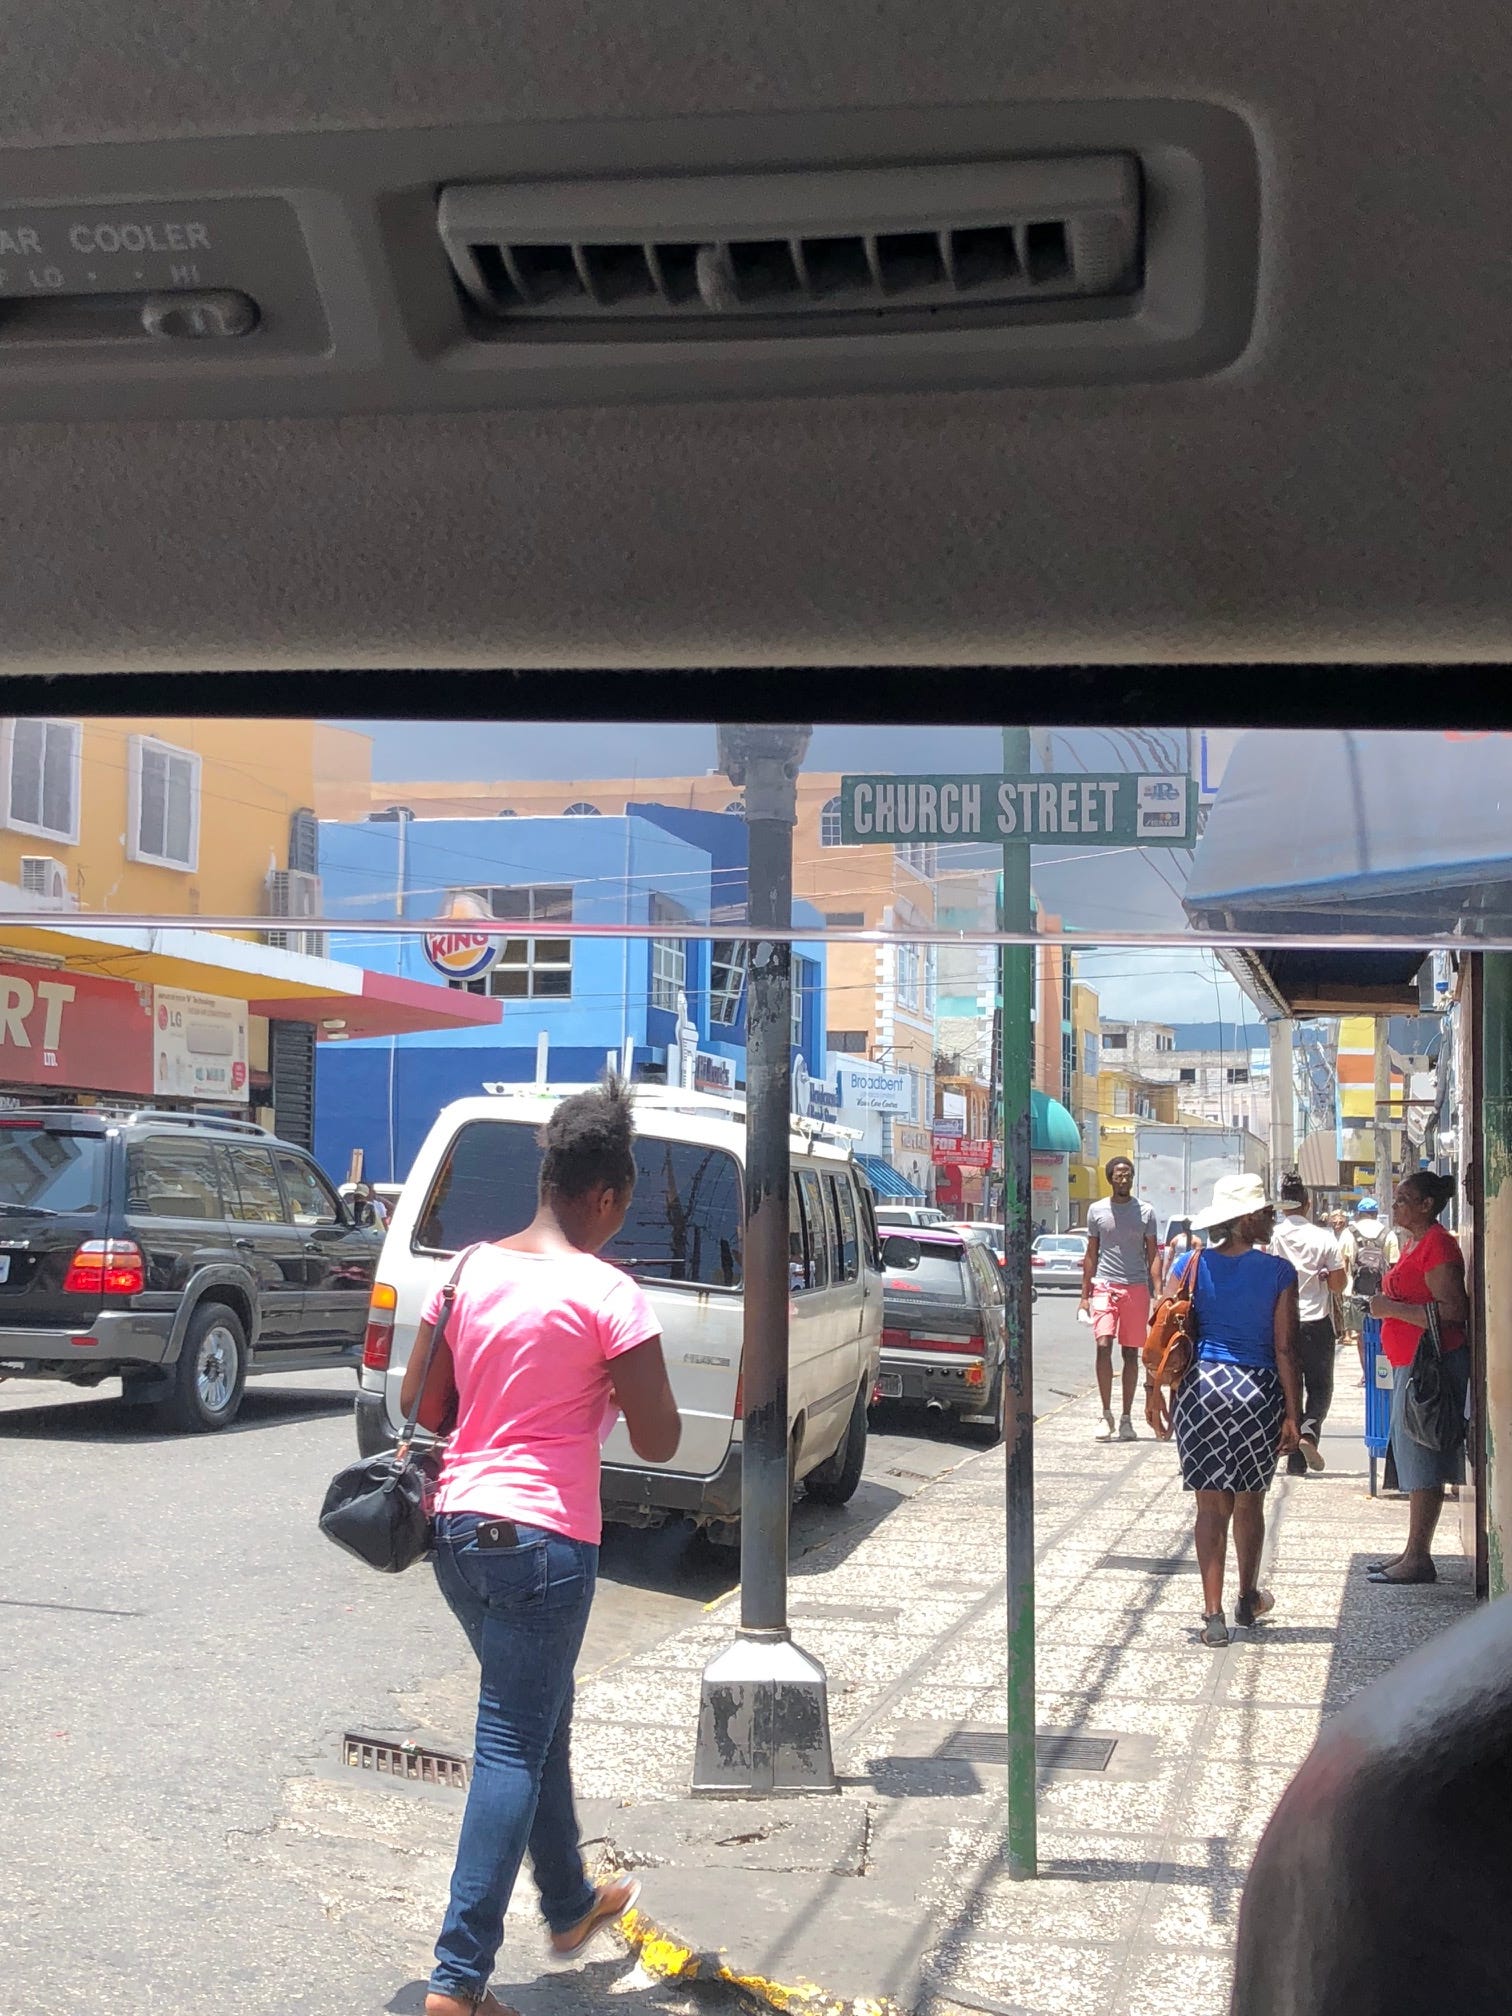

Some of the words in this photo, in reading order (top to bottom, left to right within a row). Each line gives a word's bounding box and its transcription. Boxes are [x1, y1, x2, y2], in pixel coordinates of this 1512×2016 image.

[68, 222, 212, 254] COOLER
[854, 782, 981, 834] CHURCH
[997, 781, 1120, 833] STREET
[0, 974, 76, 1050] RT
[169, 1009, 182, 1028] LG
[851, 1073, 903, 1091] Broadbent
[933, 1136, 957, 1151] FOR
[960, 1139, 991, 1154] SALE
